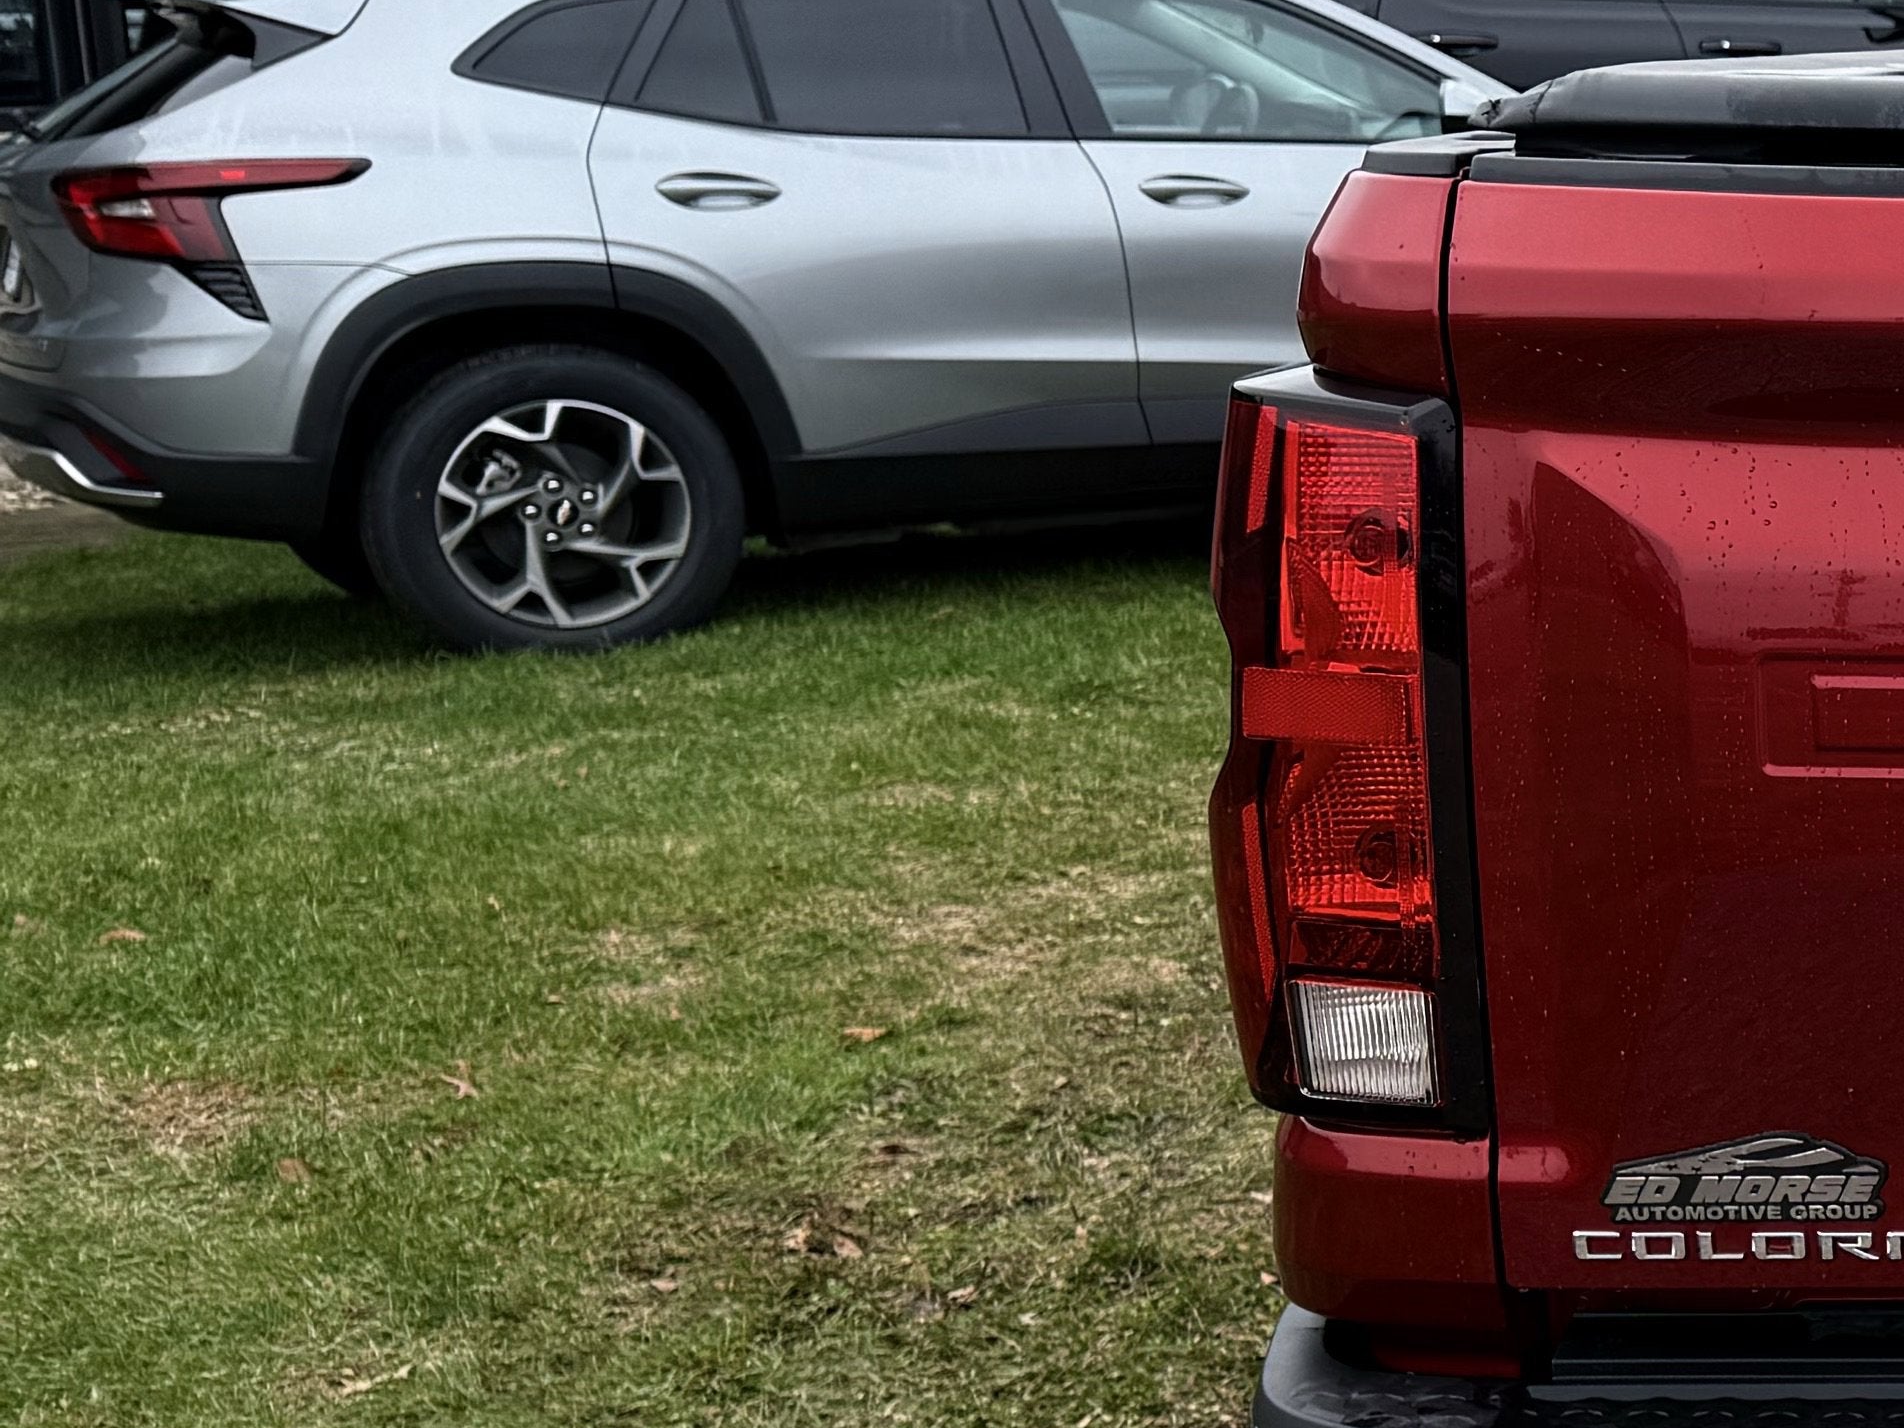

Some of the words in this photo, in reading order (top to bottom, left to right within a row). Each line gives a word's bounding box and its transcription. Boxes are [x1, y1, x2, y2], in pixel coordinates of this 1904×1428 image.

[1603, 1174, 1682, 1205] ED
[1699, 1174, 1881, 1205] MORSE
[1614, 1204, 1783, 1222] AUTOMOTIVE
[1789, 1203, 1879, 1221] GROUP
